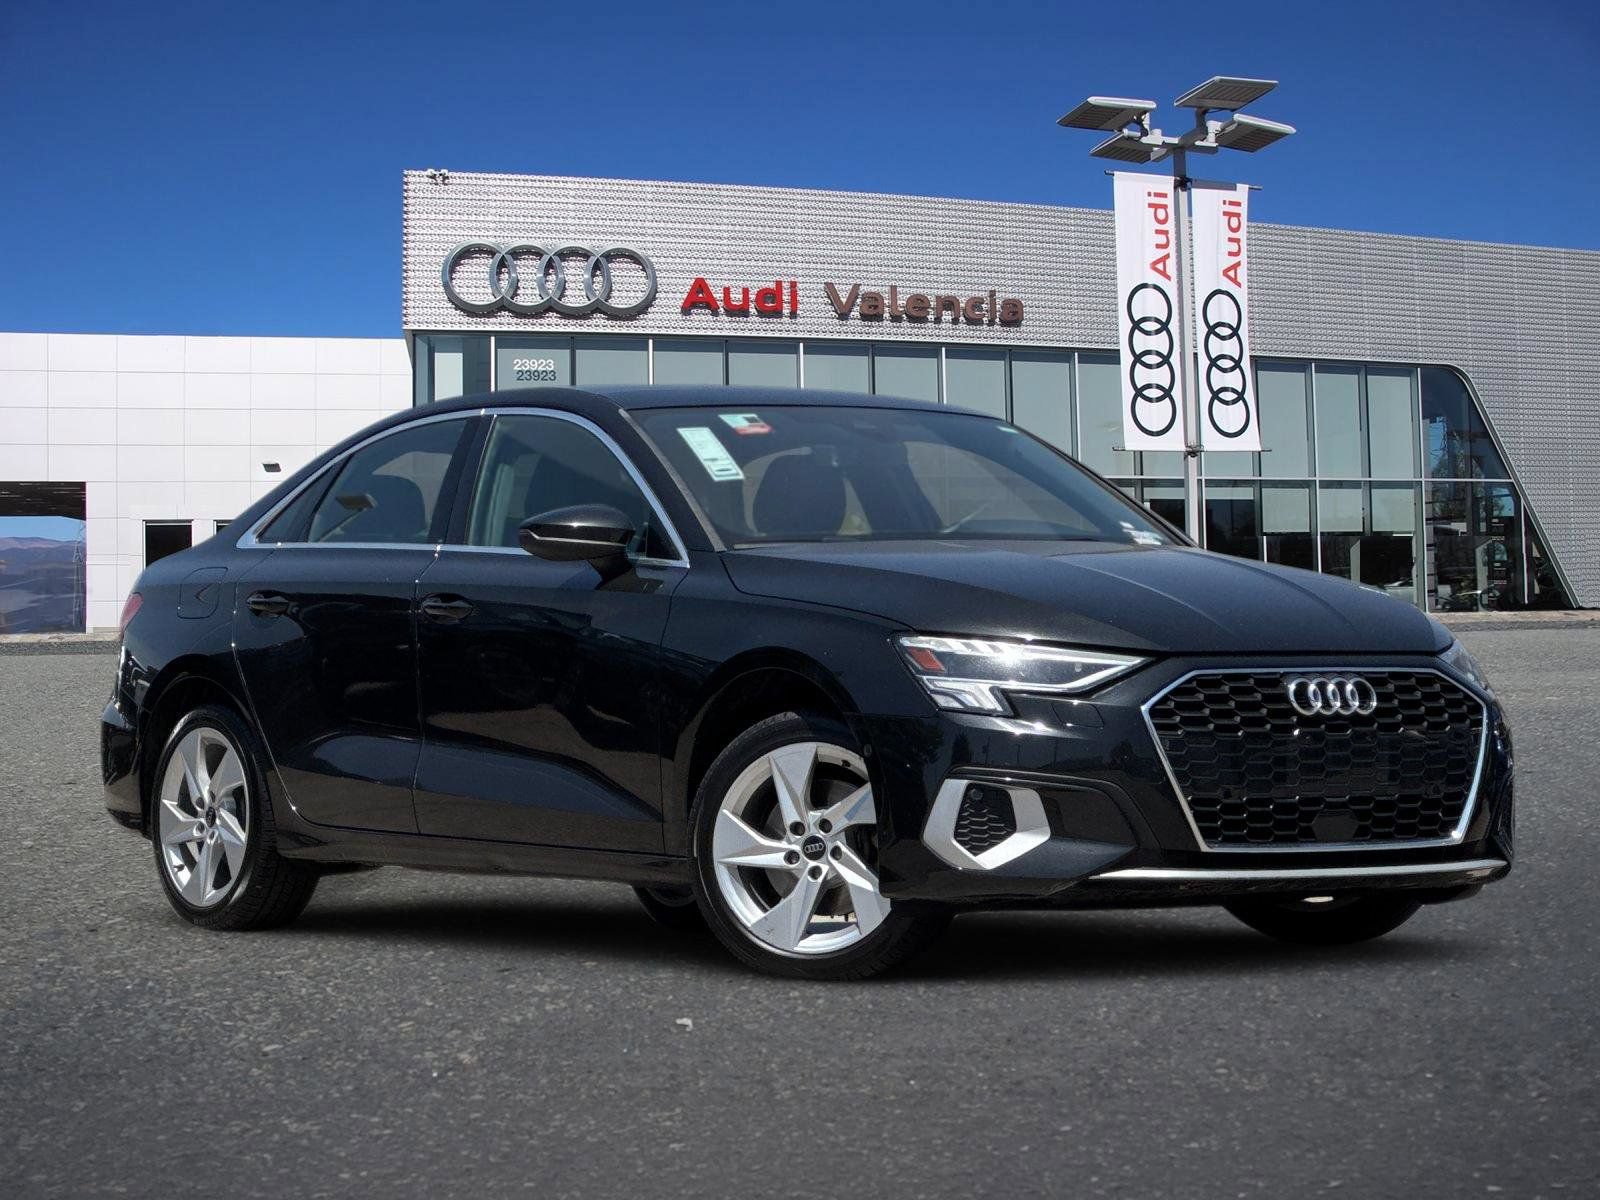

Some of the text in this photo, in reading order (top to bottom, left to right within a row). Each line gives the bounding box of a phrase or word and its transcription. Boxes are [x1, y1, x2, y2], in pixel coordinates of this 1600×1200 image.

[1147, 191, 1172, 282] Audi
[1222, 199, 1242, 289] Audi
[680, 277, 1024, 325] Audi Valencia
[513, 359, 554, 370] 23923
[516, 370, 557, 381] 23923
